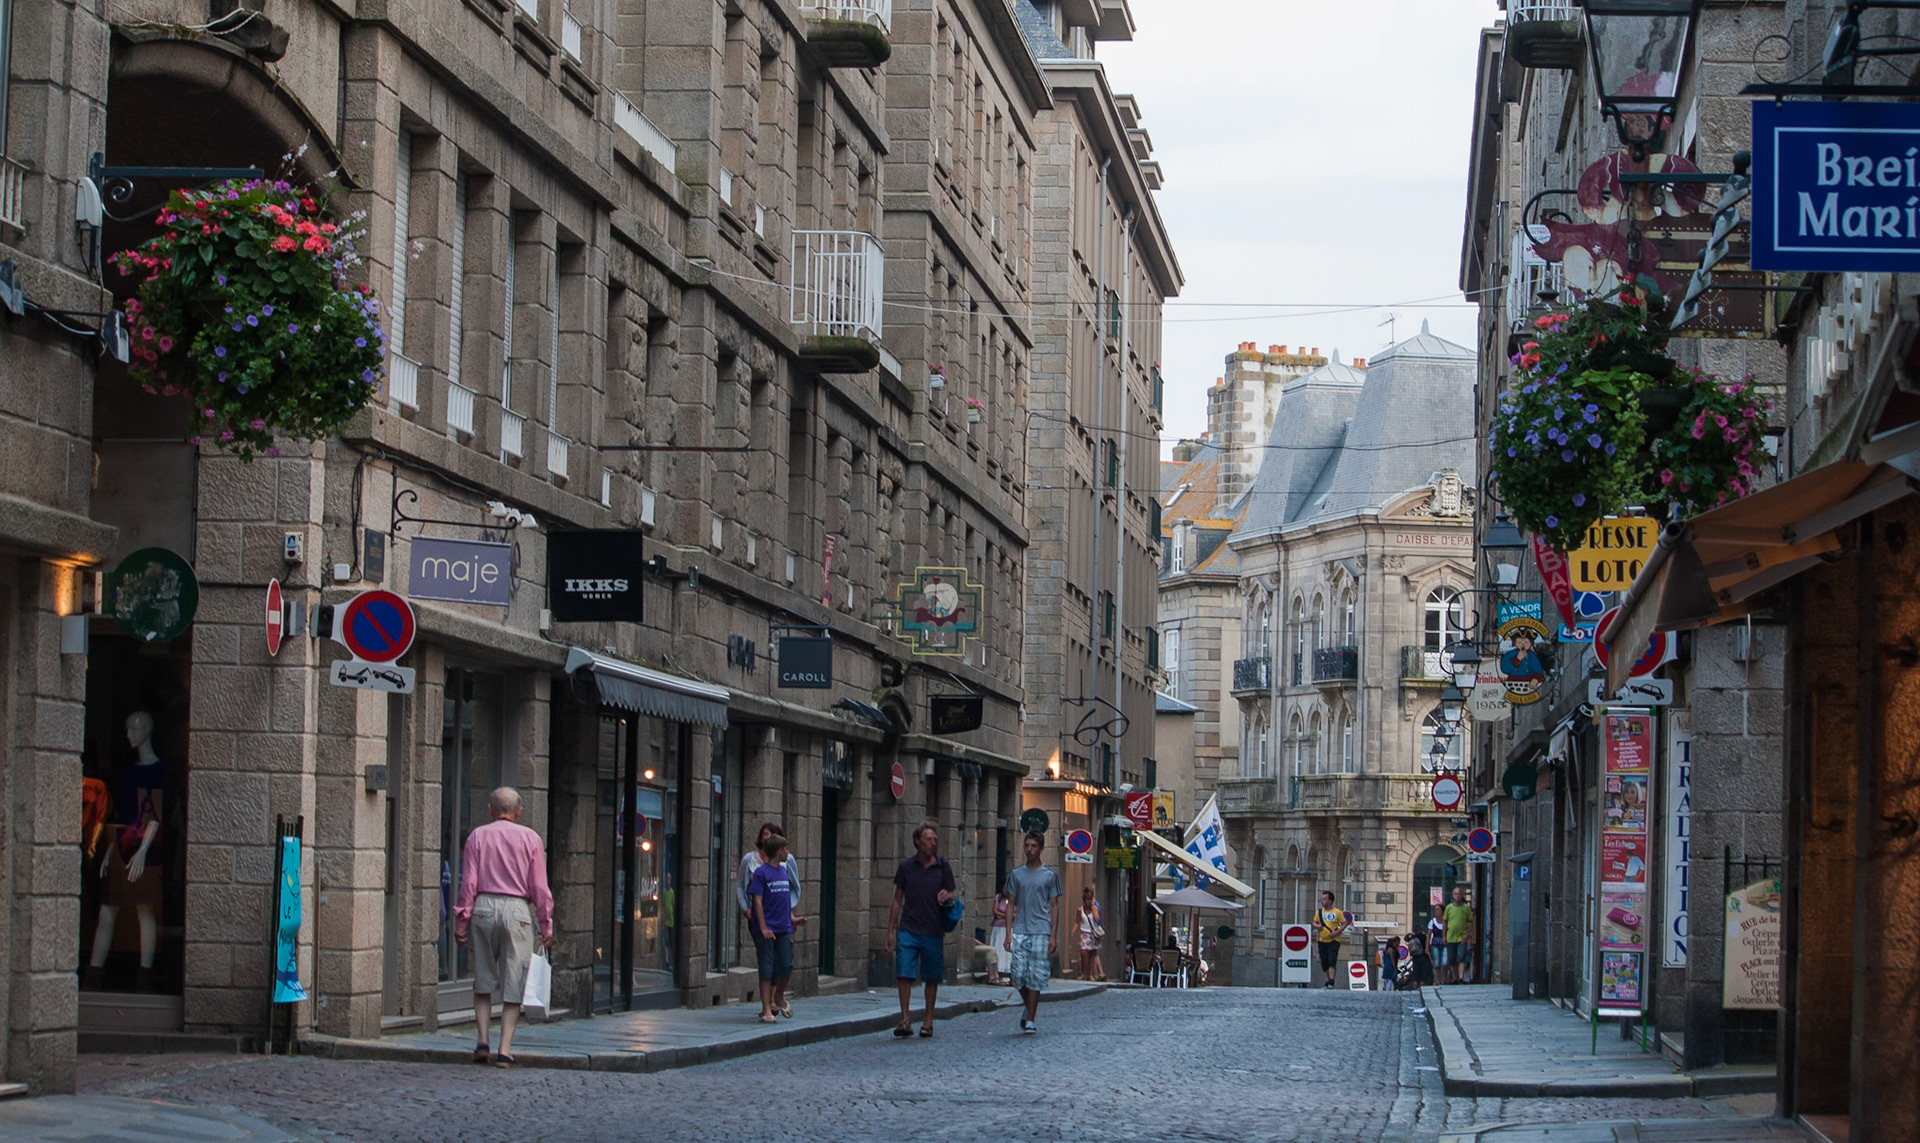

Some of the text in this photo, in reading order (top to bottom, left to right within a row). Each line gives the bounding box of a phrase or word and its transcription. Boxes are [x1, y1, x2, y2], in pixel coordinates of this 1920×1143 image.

[1816, 142, 1920, 188] Brei
[1797, 191, 1920, 238] Mari
[1396, 534, 1436, 545] CAISSE
[421, 555, 499, 593] maje
[1580, 559, 1644, 583] LOTO
[565, 579, 628, 592] IKKS
[1501, 603, 1541, 615] A VENDR
[782, 672, 826, 682] CAROLL
[1507, 693, 1538, 704] GALLAND
[1740, 915, 1777, 931] RUE de la
[1751, 928, 1779, 941] Crêpe
[1742, 937, 1775, 950] Galerie
[1752, 946, 1780, 956] Pizze
[1740, 958, 1762, 972] PLACE
[1750, 988, 1780, 998] Optici
